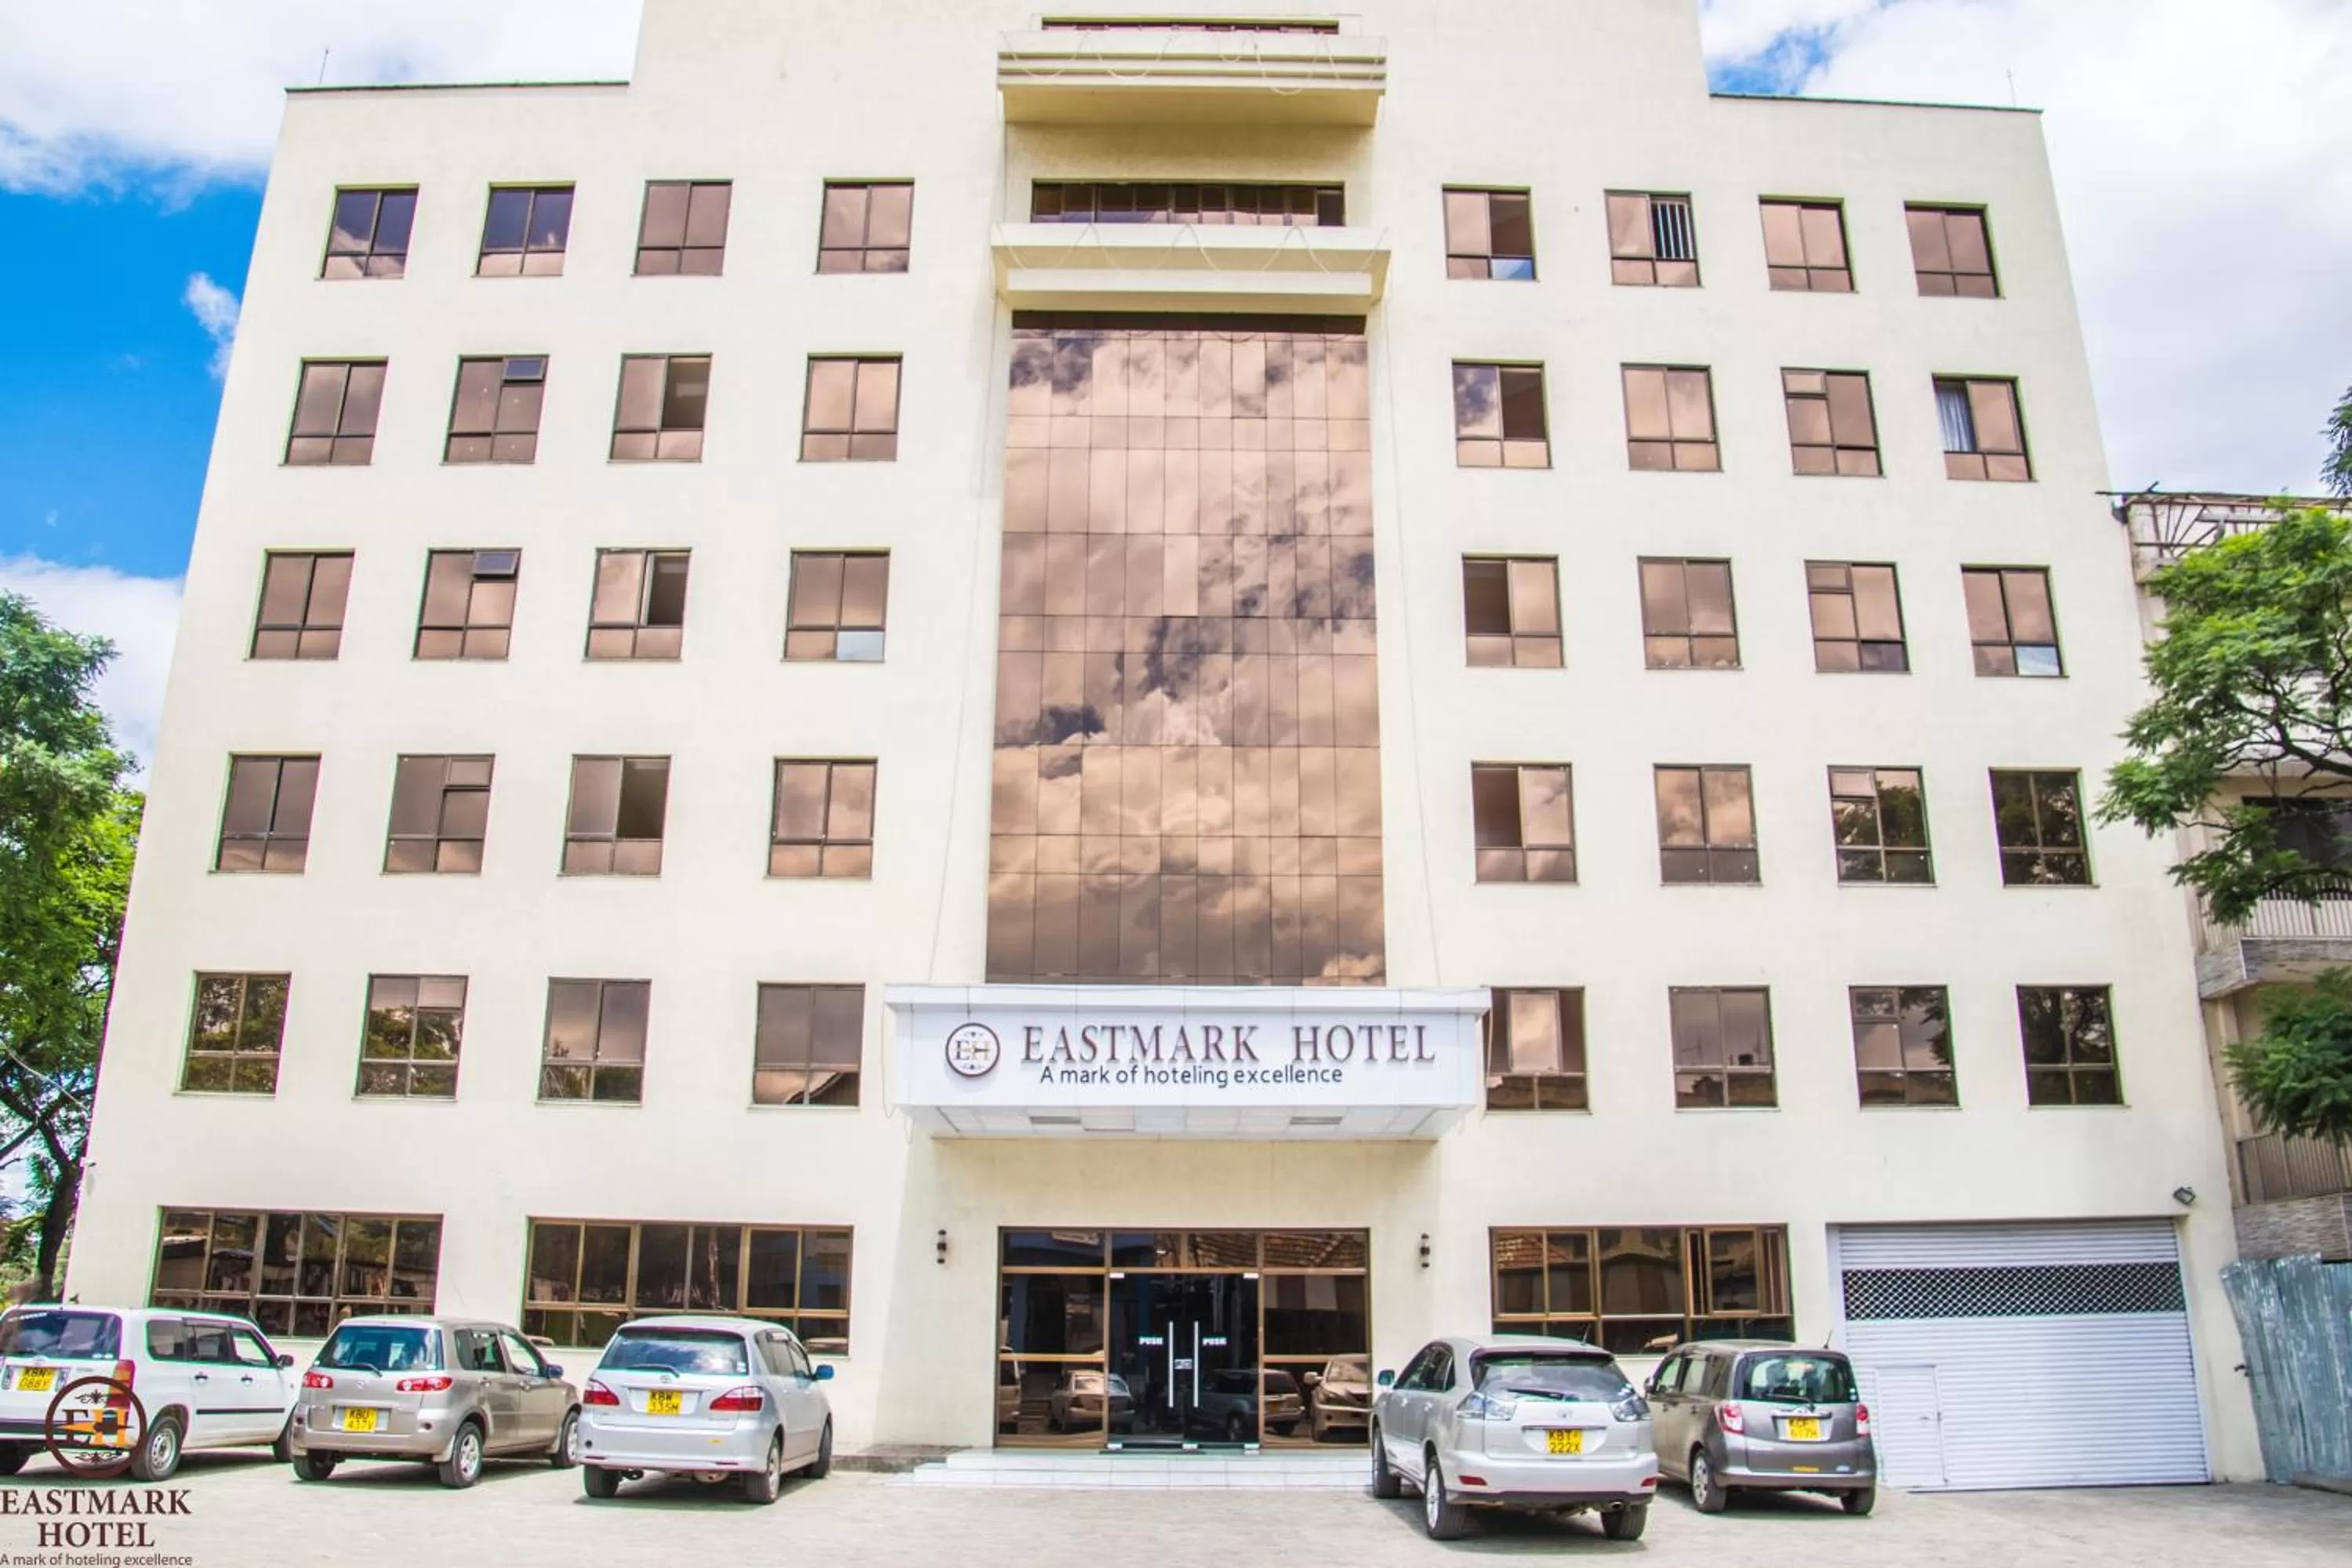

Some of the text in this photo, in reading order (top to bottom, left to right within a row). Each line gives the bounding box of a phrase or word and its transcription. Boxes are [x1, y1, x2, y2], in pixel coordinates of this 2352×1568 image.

[1021, 1024, 1436, 1063] EASTMARK HOTEL
[1040, 1064, 1343, 1089] A mark of hoteling excellence
